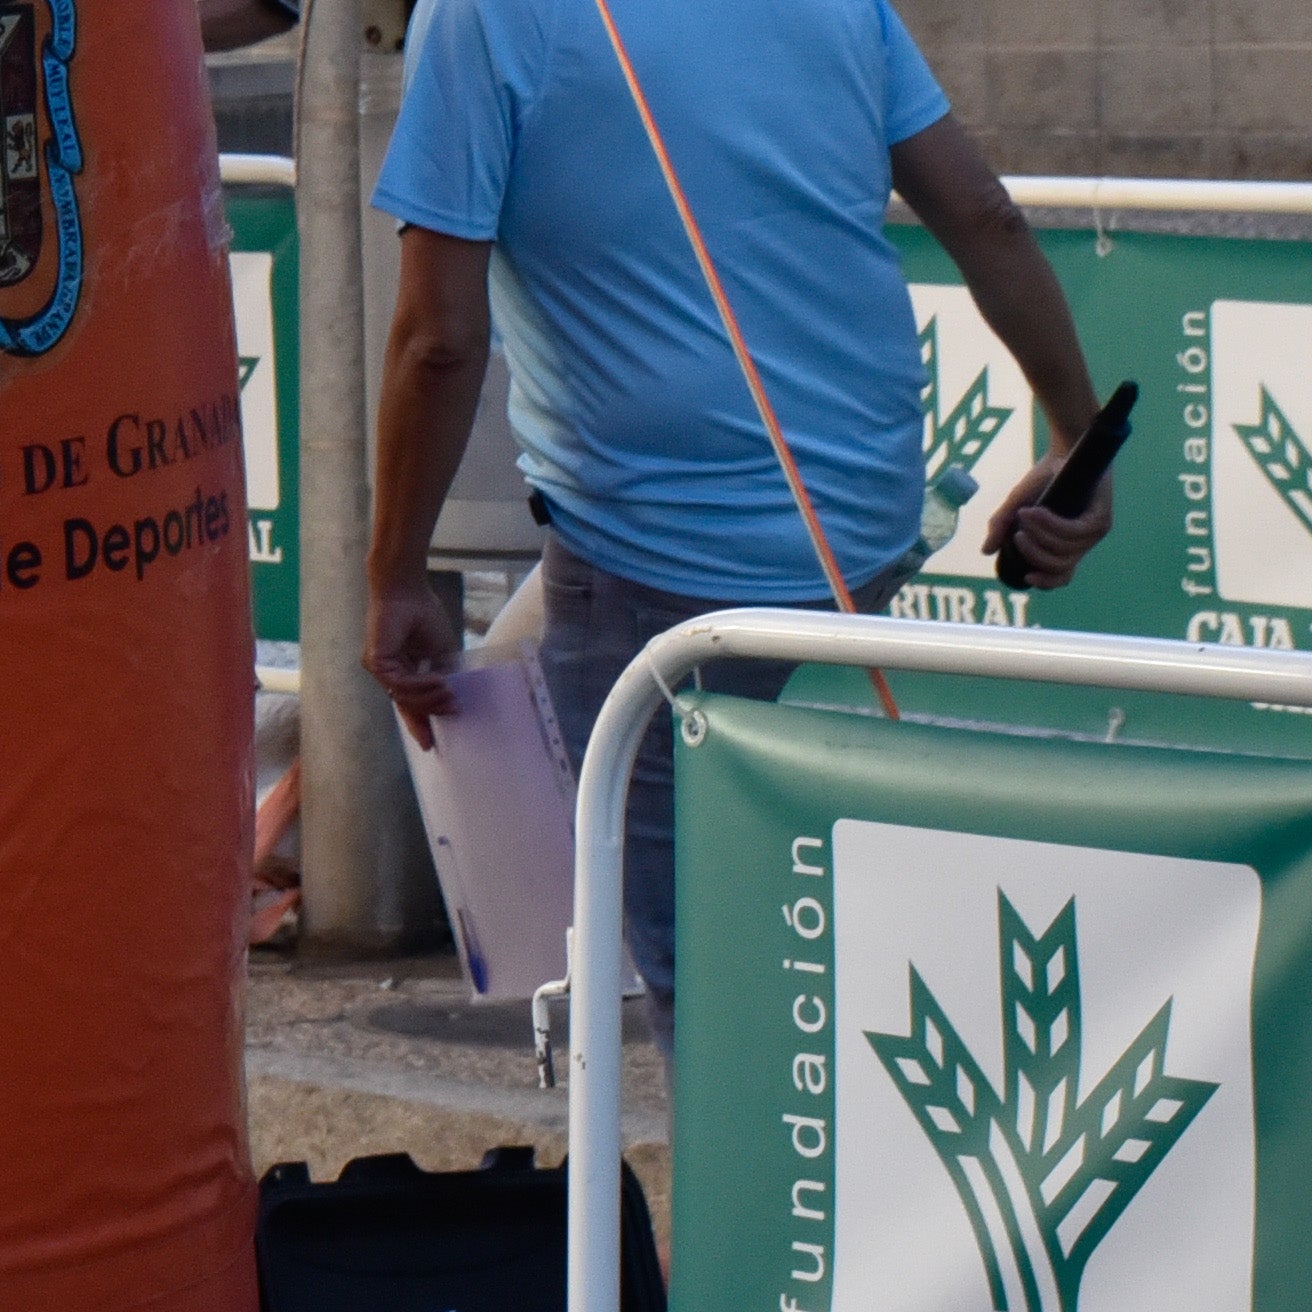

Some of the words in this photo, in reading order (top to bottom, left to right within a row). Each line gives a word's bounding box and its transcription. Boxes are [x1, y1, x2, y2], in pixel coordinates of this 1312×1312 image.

[22, 436, 90, 496] DE
[1177, 309, 1208, 597] fundación
[63, 485, 232, 583] Deportes
